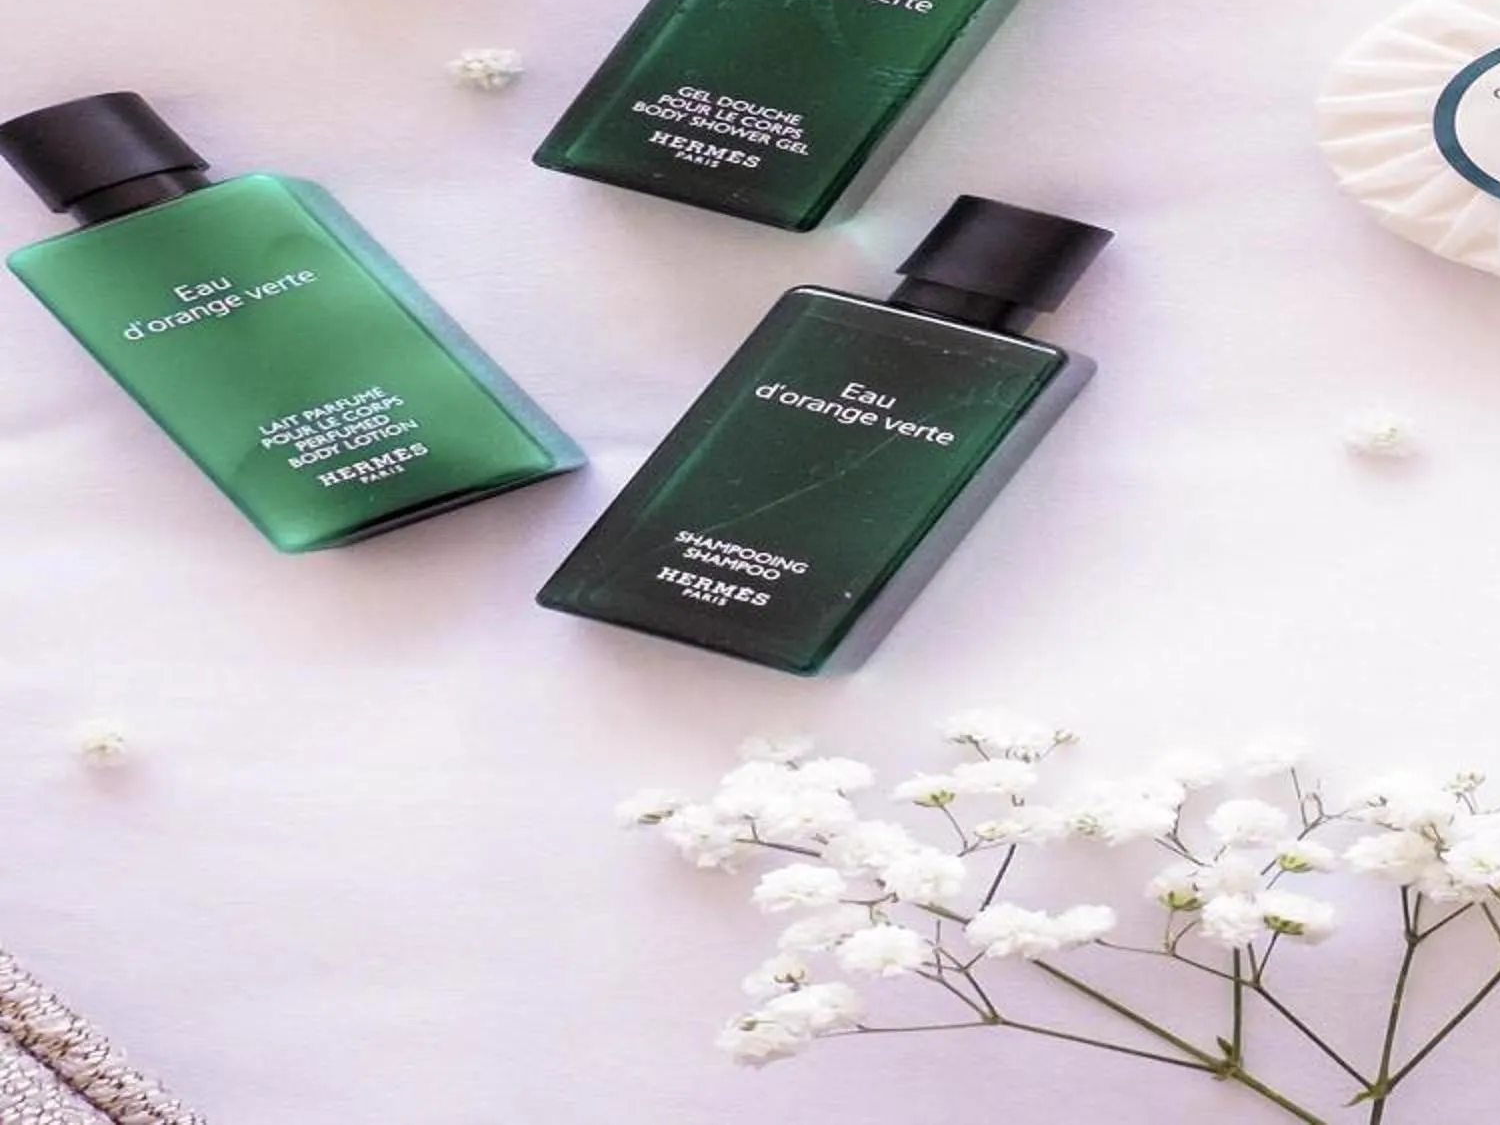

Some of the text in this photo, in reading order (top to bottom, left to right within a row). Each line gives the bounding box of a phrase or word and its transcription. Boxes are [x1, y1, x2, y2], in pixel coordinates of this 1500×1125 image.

[657, 94, 804, 140] POUR LE CORPS
[678, 86, 804, 126] GEL DOUCHE
[632, 100, 810, 156] BODY SHOWER GEL
[675, 151, 721, 168] PARIS
[123, 269, 318, 340] d'orange verte
[173, 276, 234, 302] Eau
[755, 383, 955, 446] d'orange verte
[840, 382, 897, 410] Eau
[259, 414, 299, 436] LAIT
[261, 395, 405, 450] POUR LE CORPS
[294, 414, 391, 452] PERFUMED
[287, 419, 419, 469] BODY LOTION
[359, 464, 406, 485] PARIS
[674, 530, 810, 574] SHAMPOOING
[682, 546, 781, 580] SHAMPOO
[681, 588, 730, 606] PARIS
